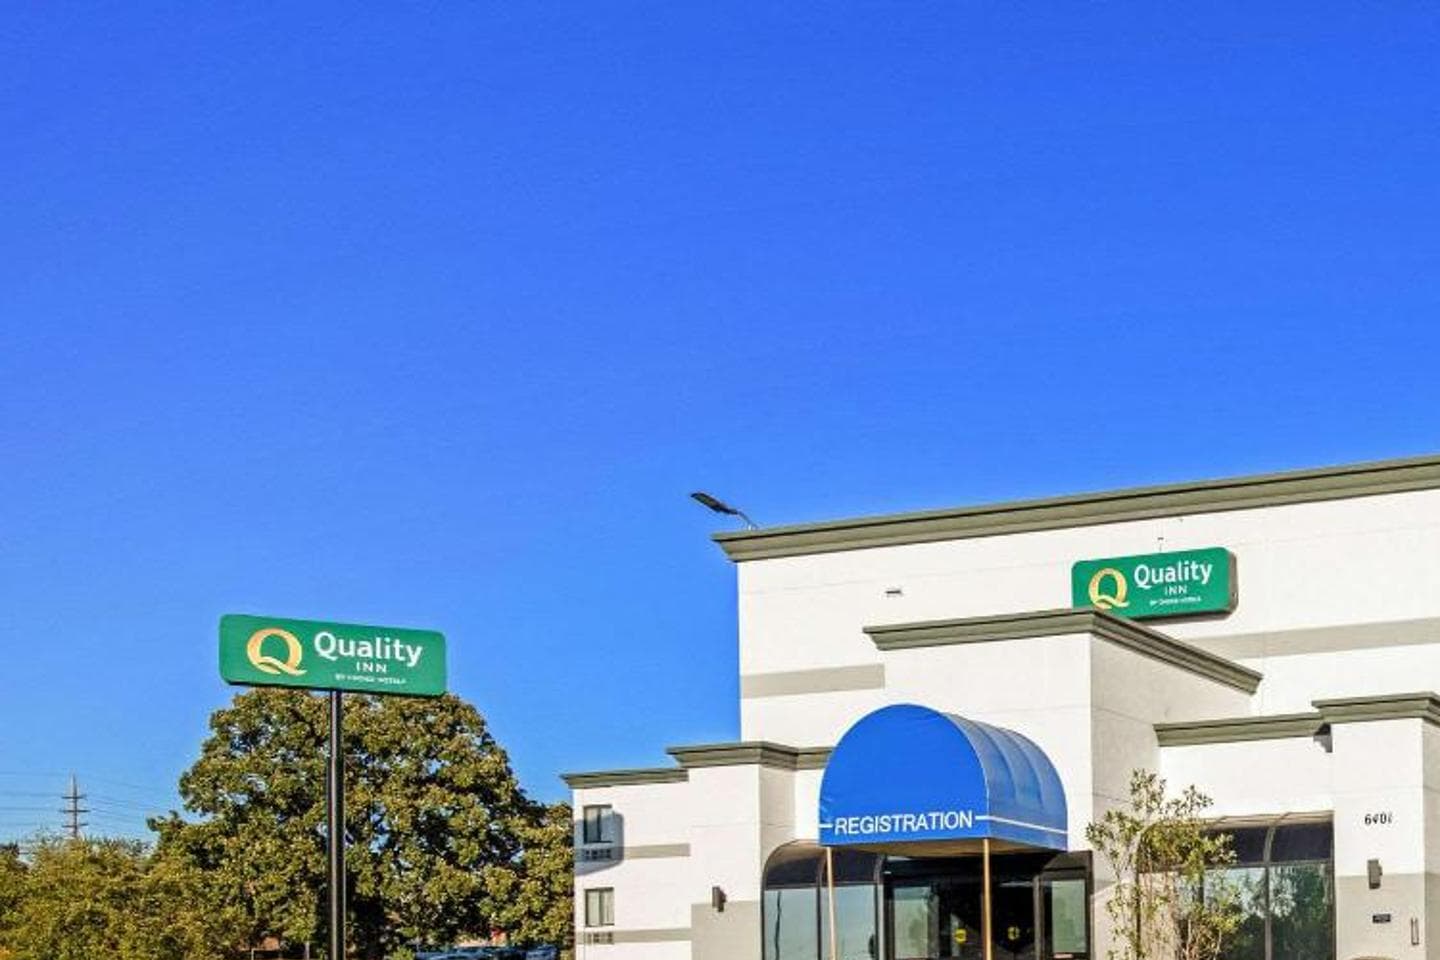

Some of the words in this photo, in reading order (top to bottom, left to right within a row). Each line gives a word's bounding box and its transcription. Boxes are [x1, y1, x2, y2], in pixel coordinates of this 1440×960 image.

[1088, 568, 1130, 609] Q
[1134, 560, 1213, 589] Quality
[1164, 585, 1187, 596] INN
[246, 628, 307, 676] Q
[314, 631, 423, 667] Quality
[356, 661, 387, 673] INN
[834, 810, 973, 836] REGISTRATION
